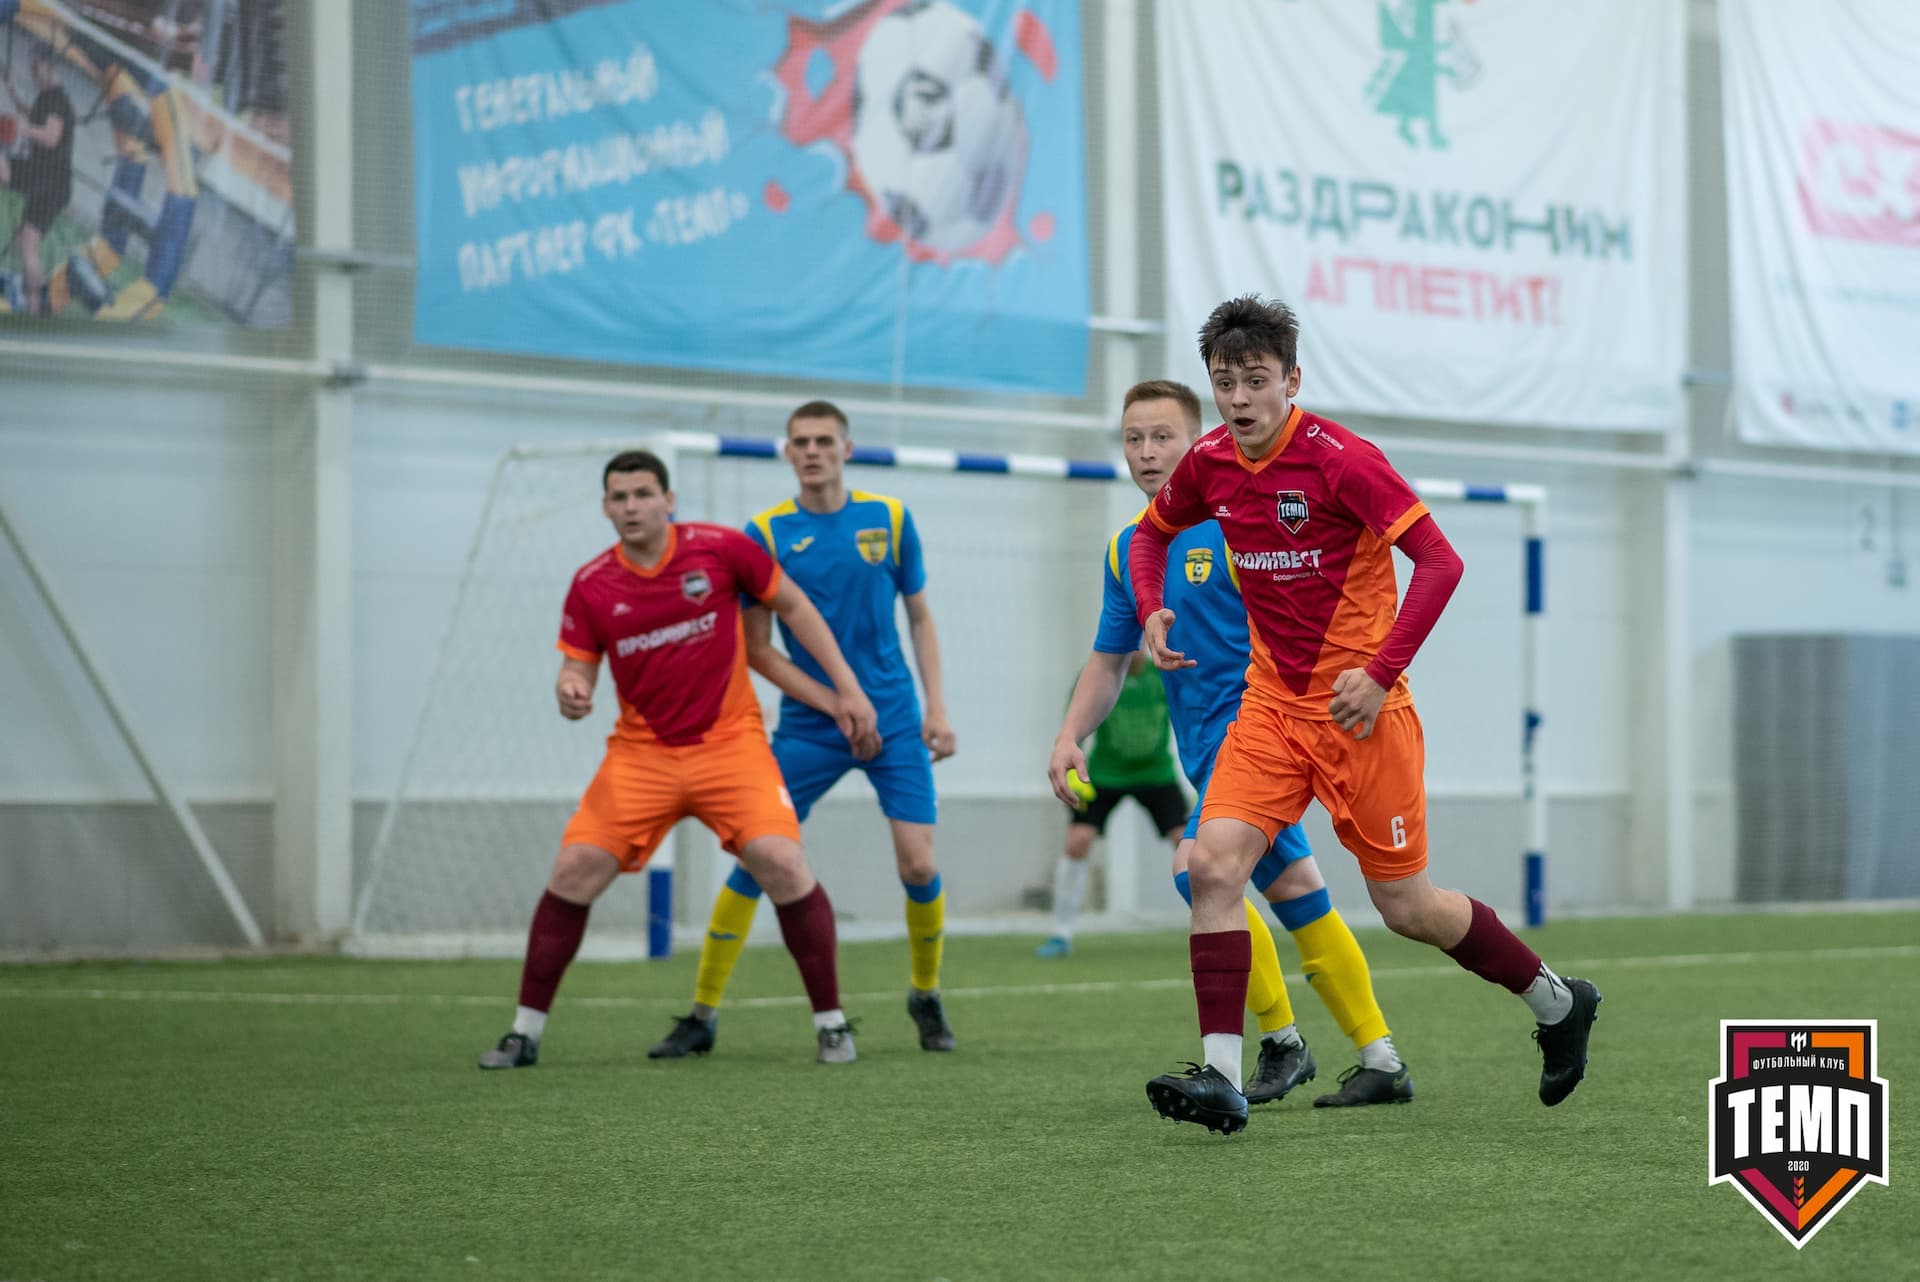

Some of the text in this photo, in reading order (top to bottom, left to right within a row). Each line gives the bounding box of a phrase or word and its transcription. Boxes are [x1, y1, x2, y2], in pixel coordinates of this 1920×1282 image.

[1305, 256, 1562, 326] АППЕТИТ!
[1280, 503, 1305, 518] ТЕМП
[1391, 815, 1407, 849] 6
